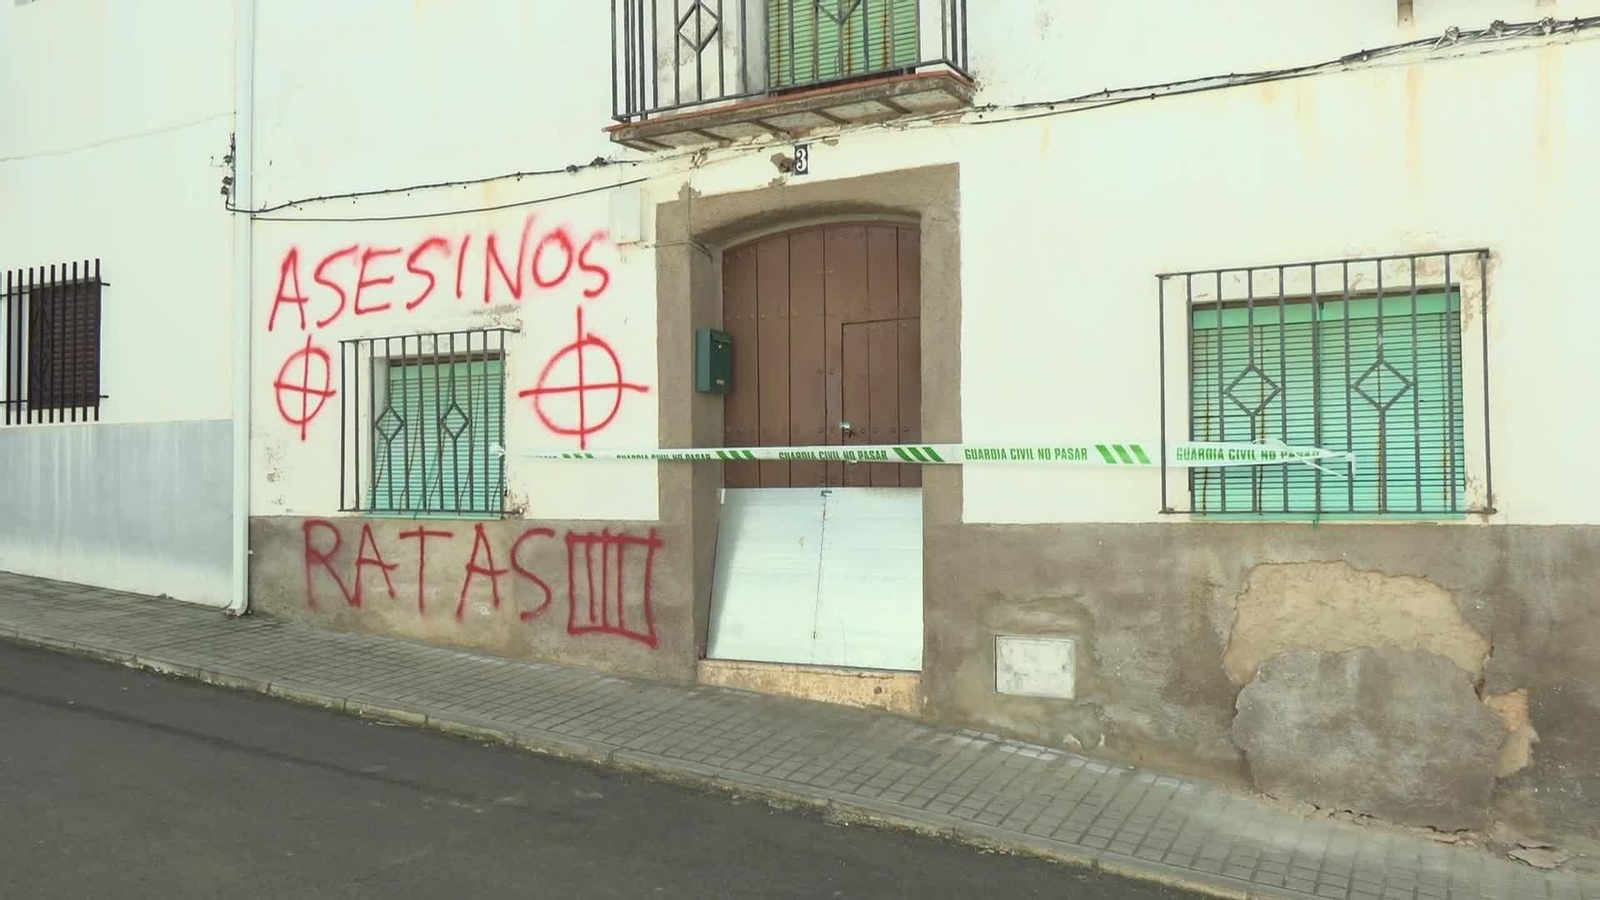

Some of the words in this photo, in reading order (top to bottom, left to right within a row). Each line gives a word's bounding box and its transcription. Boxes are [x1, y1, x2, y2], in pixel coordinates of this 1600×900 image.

[796, 148, 807, 172] 3
[267, 214, 611, 332] ASESINOS
[778, 451, 817, 461] GUARDIA
[819, 450, 841, 461] CIVIL
[843, 450, 856, 461] NO
[857, 449, 889, 461] PASAR
[964, 448, 1008, 461] GUARDIA
[1010, 447, 1035, 461] CIVIL
[1038, 447, 1052, 461] NO
[1055, 447, 1088, 461] PASAR
[1176, 446, 1224, 461] GUARDIA
[1228, 448, 1257, 461] CIVIL
[302, 518, 555, 624] RATAS
